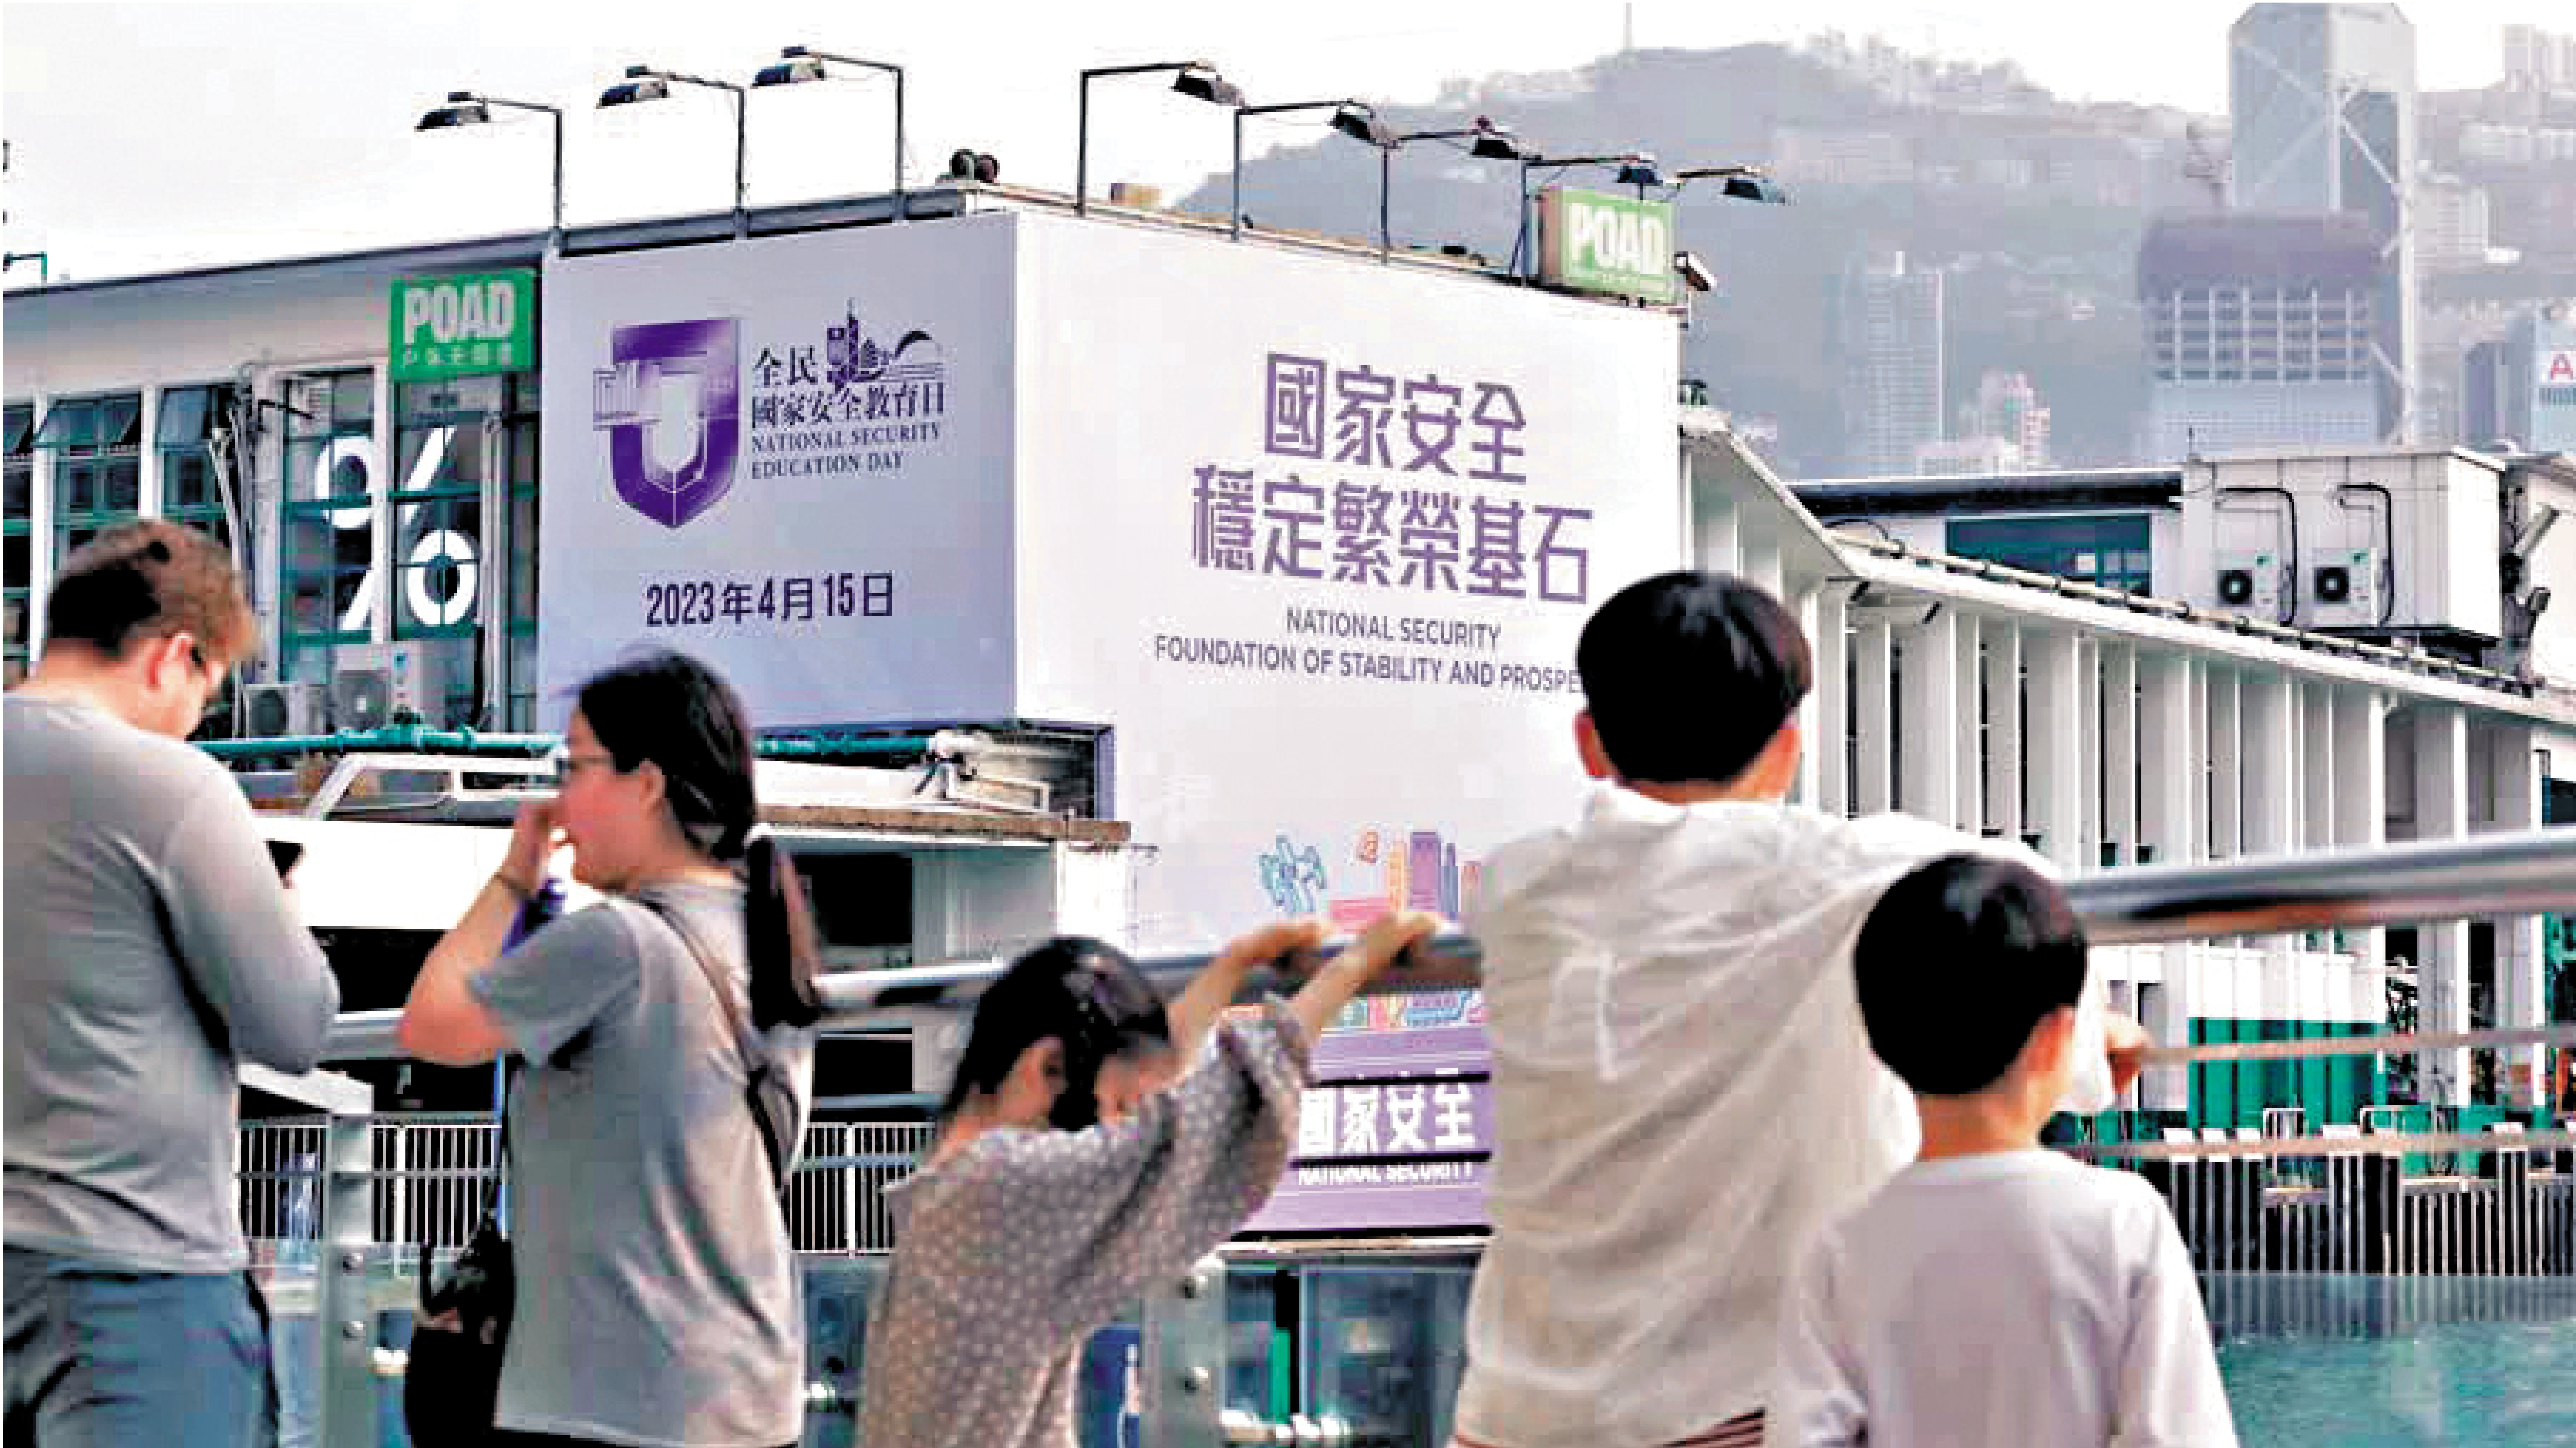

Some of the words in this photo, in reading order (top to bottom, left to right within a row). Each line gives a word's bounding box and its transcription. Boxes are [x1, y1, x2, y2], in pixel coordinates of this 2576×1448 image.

[1570, 204, 1664, 275] POAD
[405, 280, 515, 344] POAD
[754, 345, 817, 387] 全民
[752, 381, 944, 428] 國家安全教育日
[1264, 351, 1527, 484] 國家安全
[752, 430, 843, 453] NATIONAL
[851, 422, 940, 446] SECURITY
[752, 456, 859, 480] EDUCATION
[868, 451, 903, 472] DAY
[1190, 464, 1593, 604] 穩定繁榮基石
[646, 571, 893, 627] 2023年4月15日
[1286, 606, 1393, 642] NATIONAL
[1399, 617, 1503, 650] SECURITY
[1154, 634, 1297, 671] FOUNDATION
[1303, 649, 1332, 675] OF
[1338, 652, 1442, 684] STABILITY
[1449, 660, 1495, 688] AND
[1500, 664, 1584, 693] PROSPE
[1298, 1067, 1476, 1156] 國家安全
